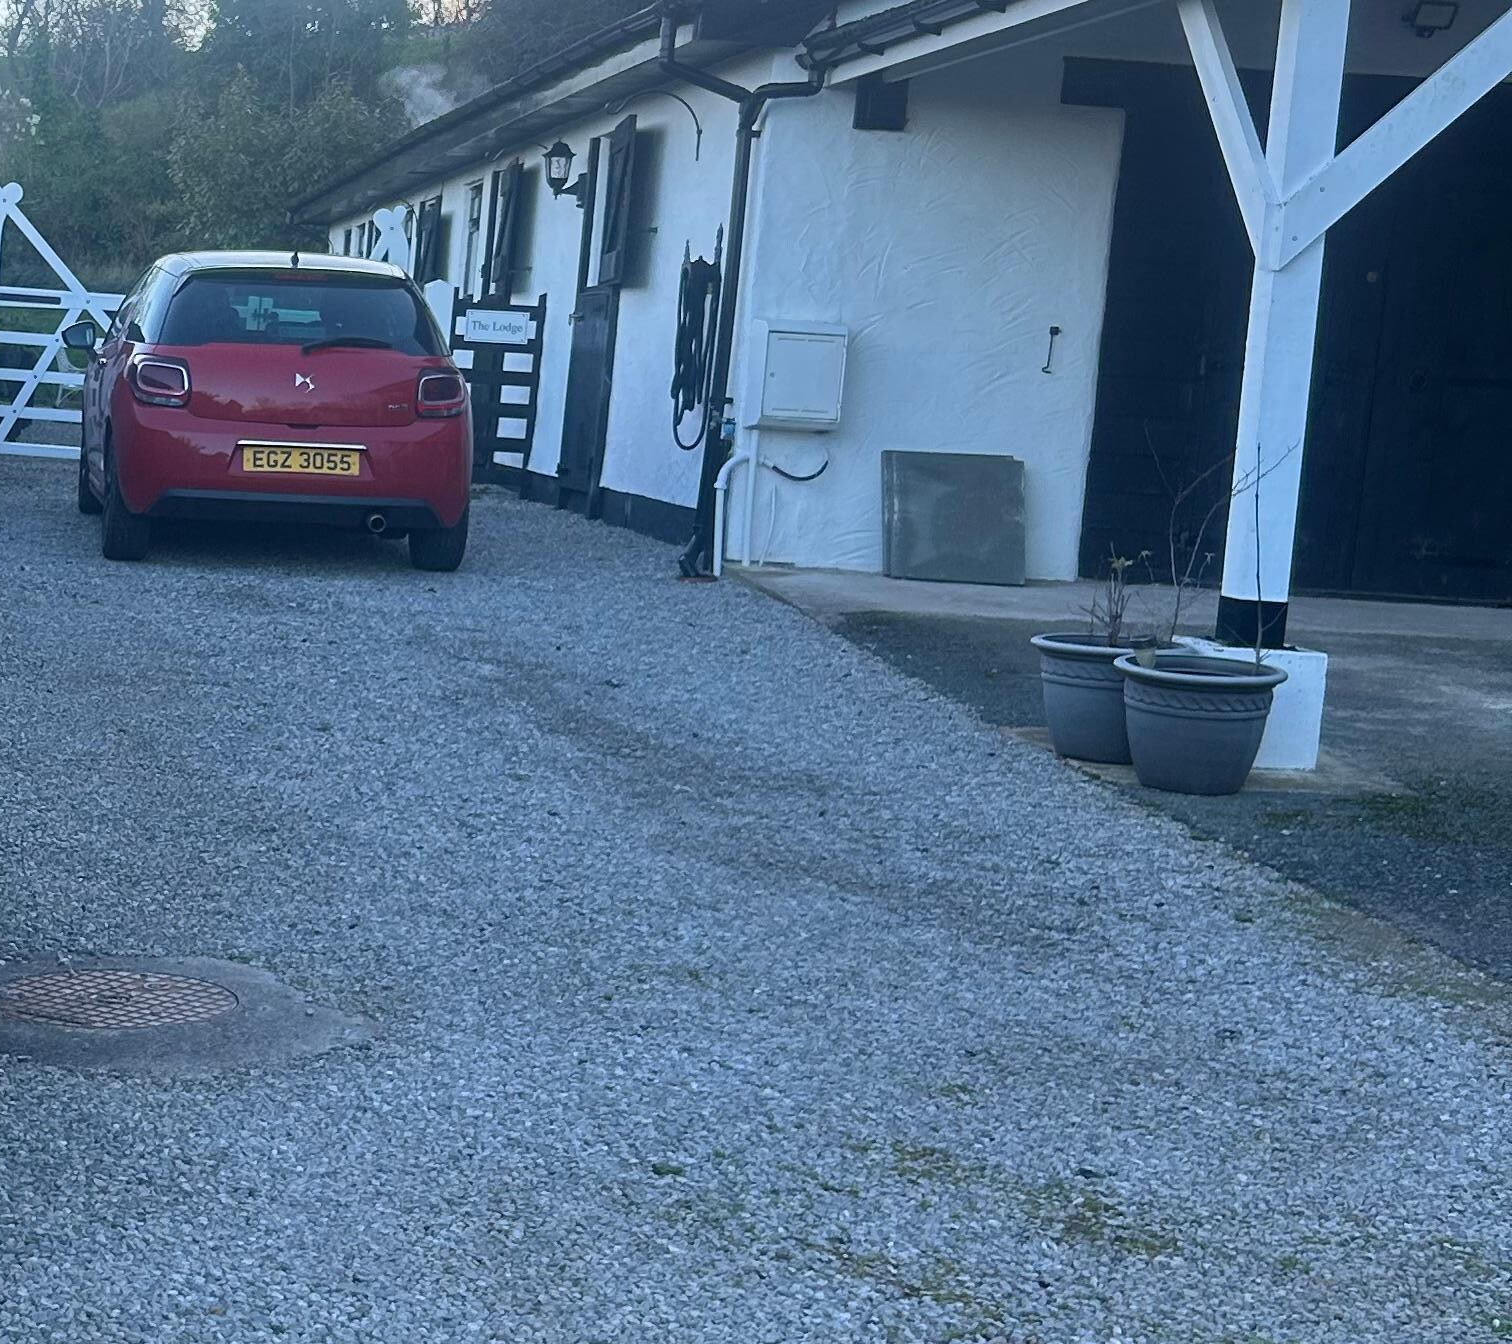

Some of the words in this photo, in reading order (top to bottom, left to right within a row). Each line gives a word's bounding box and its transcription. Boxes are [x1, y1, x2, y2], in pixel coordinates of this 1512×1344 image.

[472, 320, 489, 332] The
[492, 321, 524, 335] Lodge
[253, 450, 293, 468] EGZ
[298, 451, 352, 472] 3055
